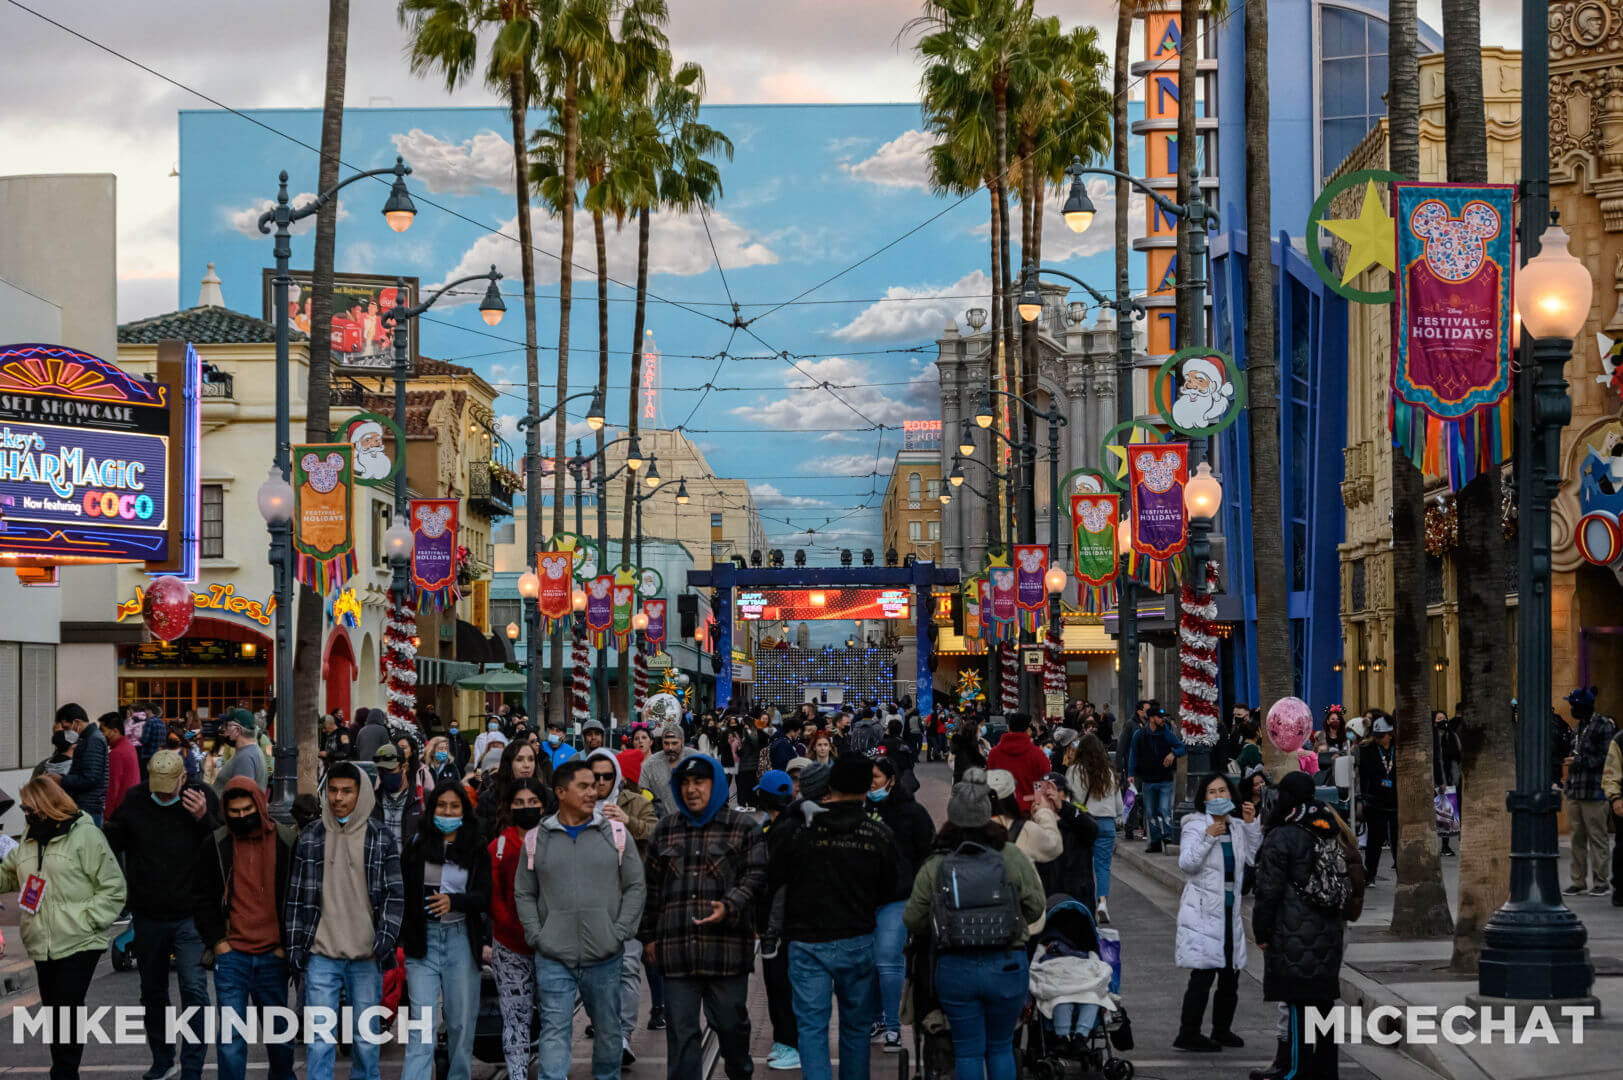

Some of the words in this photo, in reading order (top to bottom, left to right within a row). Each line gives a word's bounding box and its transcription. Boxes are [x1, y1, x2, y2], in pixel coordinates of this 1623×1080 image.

[1417, 316, 1478, 327] FESTIVAL
[1412, 326, 1494, 340] HOLIDAYS
[1, 395, 33, 412] SET
[41, 399, 134, 422] SHOWCASE
[21, 412, 81, 424] THEATER
[23, 496, 44, 510] Now
[43, 498, 82, 516] featuring
[83, 490, 154, 520] COCO
[1140, 513, 1181, 521] HOLIDAYS
